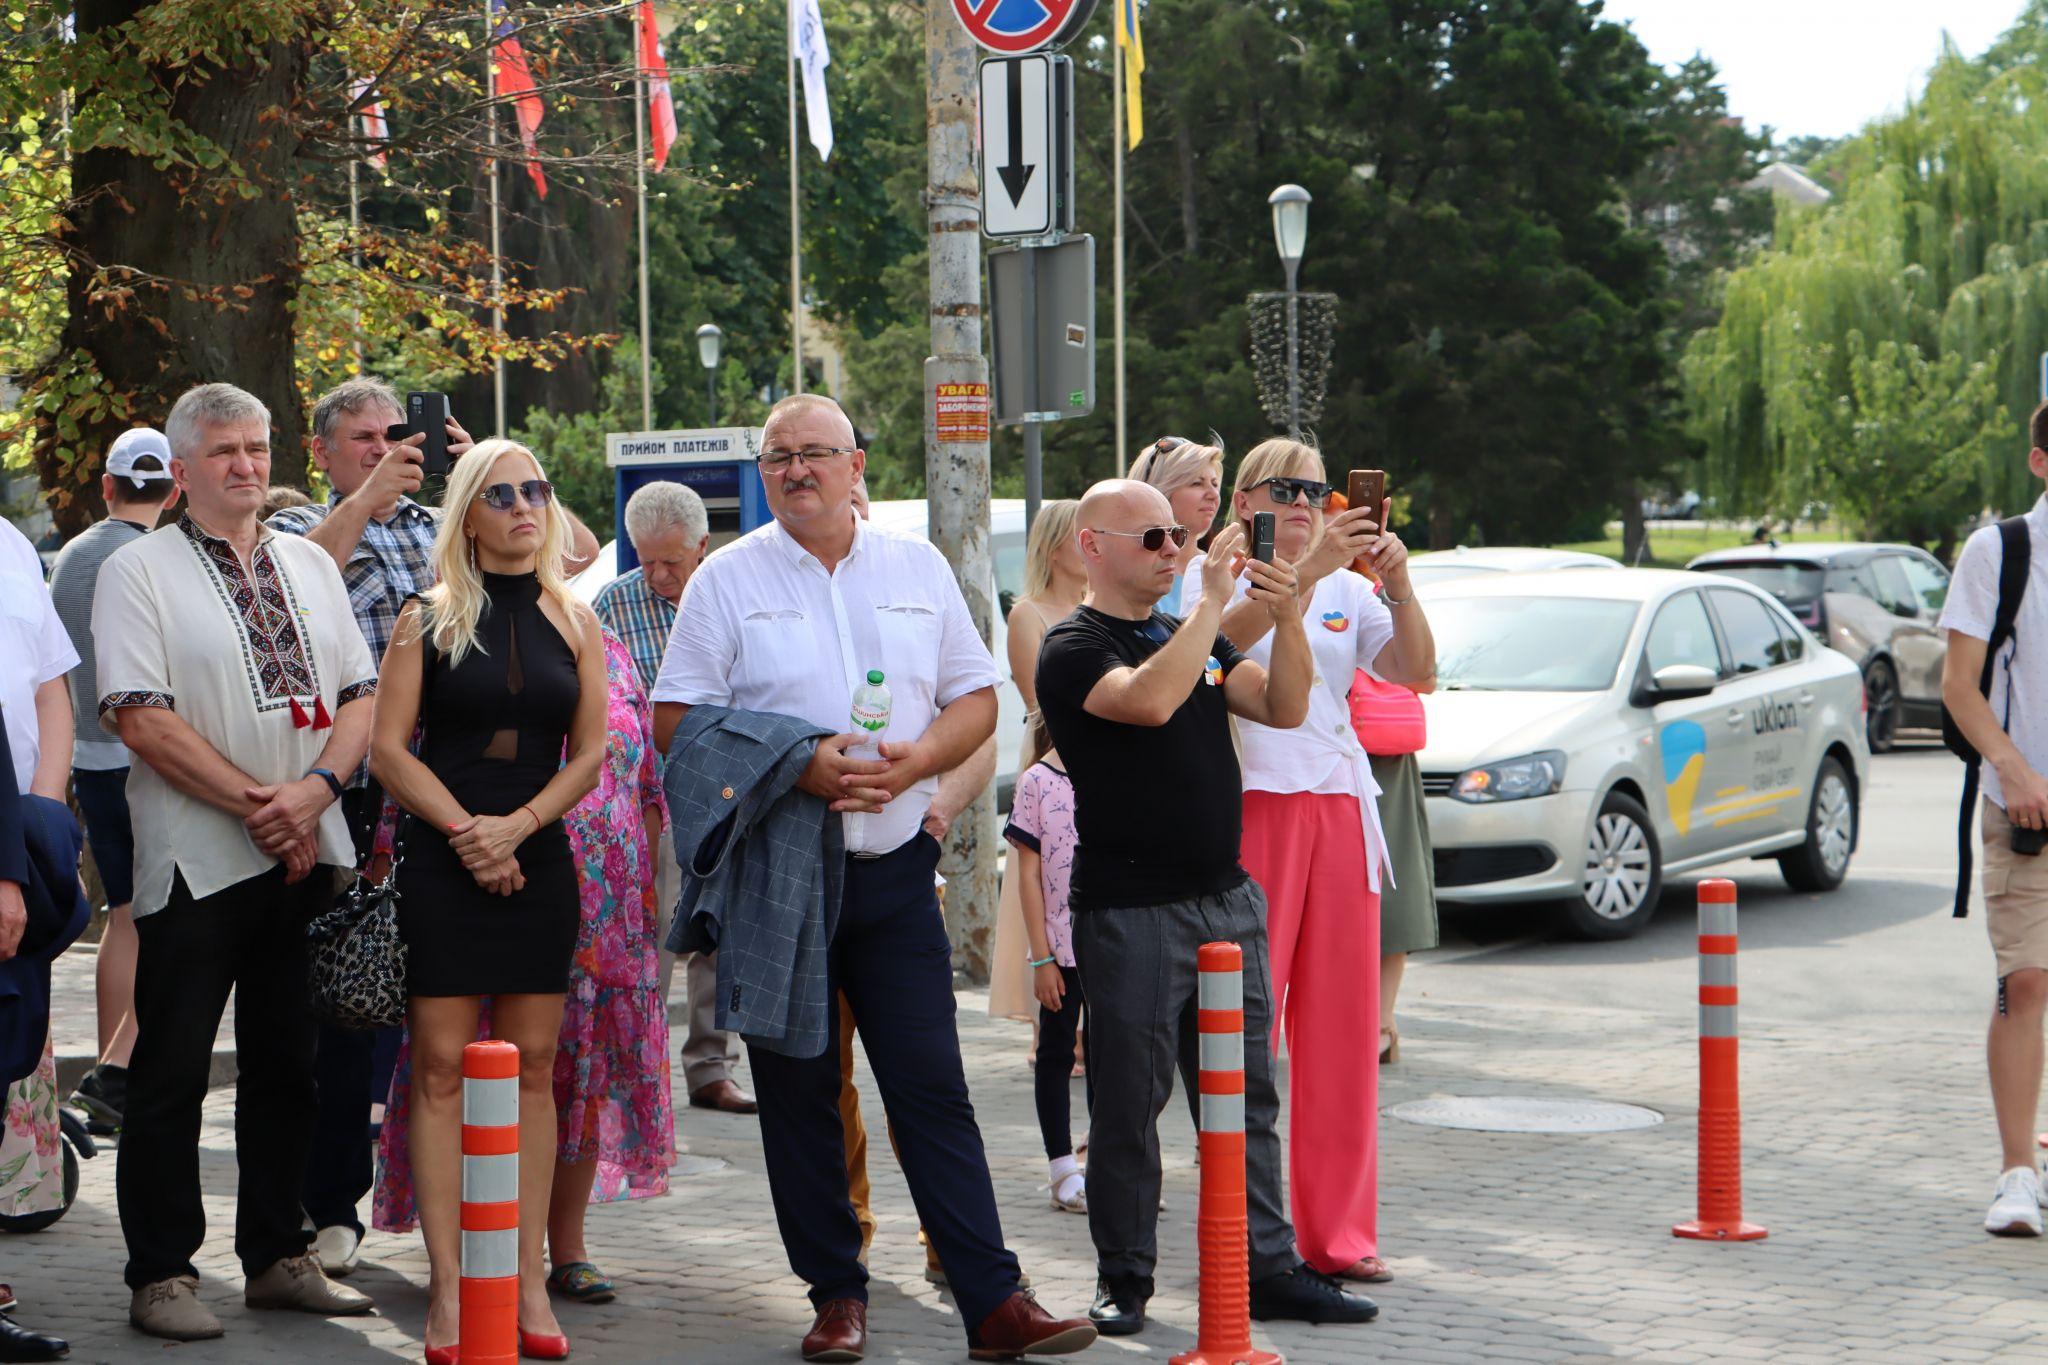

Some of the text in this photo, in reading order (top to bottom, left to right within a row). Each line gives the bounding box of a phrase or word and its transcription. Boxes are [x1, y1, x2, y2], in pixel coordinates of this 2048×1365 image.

[939, 385, 986, 396] УВАГА!
[621, 442, 666, 455] ПРИЙОМ
[673, 439, 729, 453] ПЛАТЕЖІВ
[1751, 695, 1798, 735] uklon
